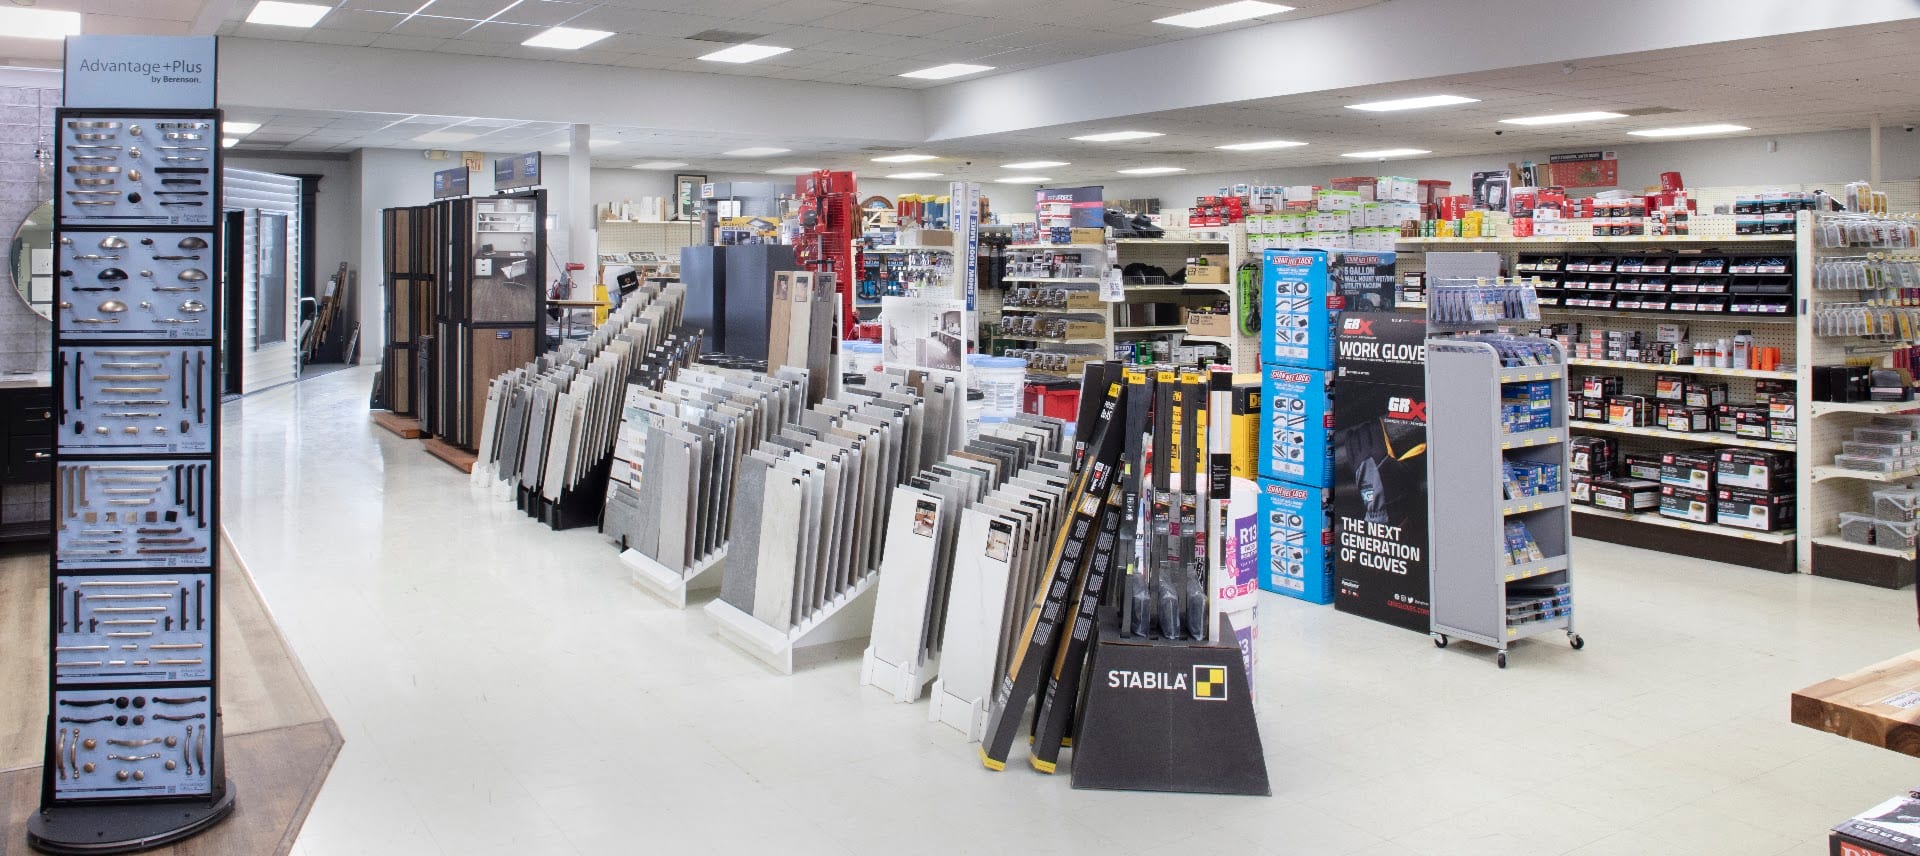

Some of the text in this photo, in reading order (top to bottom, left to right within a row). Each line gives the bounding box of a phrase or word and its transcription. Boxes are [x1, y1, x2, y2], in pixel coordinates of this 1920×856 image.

[969, 218, 977, 242] RAKE
[968, 244, 976, 266] ROOF
[967, 267, 976, 296] SNOW
[1344, 266, 1375, 275] 5 GALLON
[1340, 341, 1379, 358] WORK
[1388, 396, 1426, 422] GRX
[1239, 524, 1257, 545] R13
[1341, 517, 1401, 541] THE NEXT
[1341, 532, 1420, 562] GENERATION
[1341, 548, 1407, 575] OF GLOVES
[1108, 670, 1187, 690] STABILA
